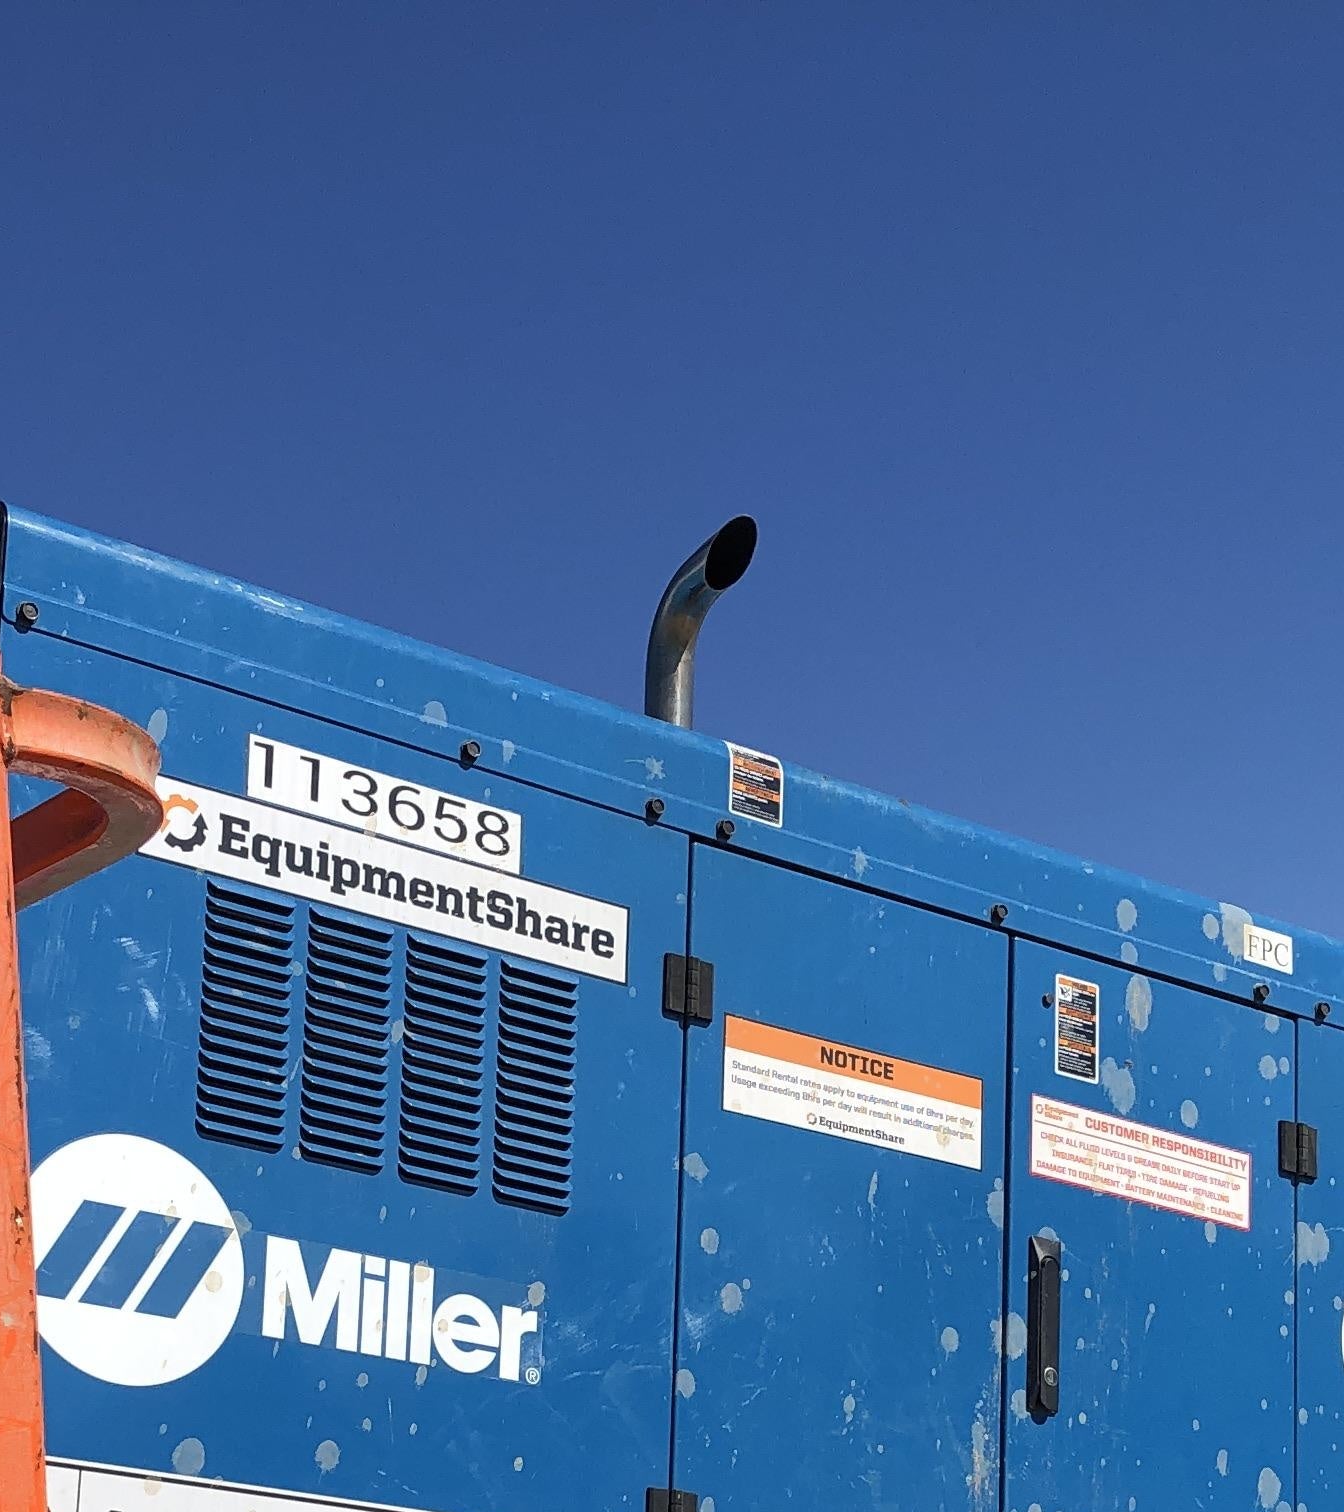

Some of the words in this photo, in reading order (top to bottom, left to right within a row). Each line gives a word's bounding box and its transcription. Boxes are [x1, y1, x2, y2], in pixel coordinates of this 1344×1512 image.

[253, 740, 511, 857] 113658
[217, 811, 615, 960] EquipmentShare
[1247, 933, 1290, 968] FPC
[820, 1046, 894, 1081] NOTICE
[731, 1074, 757, 1089] Usage
[758, 1082, 800, 1101] exceeding
[822, 1098, 836, 1107] per
[837, 1100, 853, 1113] day
[853, 1105, 867, 1115] will
[868, 1109, 892, 1121] result
[893, 1114, 902, 1123] in
[902, 1117, 943, 1133] additional
[732, 1060, 770, 1077] Standard
[772, 1070, 798, 1085] Rental
[800, 1078, 821, 1090] rates
[823, 1084, 845, 1098] apply
[846, 1089, 855, 1098] to
[857, 1092, 899, 1109] equipment
[901, 1102, 914, 1112] use
[916, 1106, 925, 1115] of
[945, 1114, 958, 1124] per
[818, 1115, 905, 1146] EquipmentShare
[1085, 1117, 1149, 1145] CUSTOMER
[1151, 1135, 1248, 1172] RESPONSIBILITY
[1035, 1160, 1066, 1174] DAMAGE
[1067, 1168, 1077, 1177] TO
[1078, 1171, 1120, 1188] EQUIPMENT
[1040, 1131, 1064, 1144] CHECK
[1065, 1137, 1078, 1148] ALL
[1101, 1147, 1125, 1161] LEVELS
[1161, 1164, 1182, 1177] DAILY
[1182, 1170, 1208, 1184] BEFORE
[1209, 1176, 1231, 1189] START
[1098, 1161, 1114, 1172] FLAT
